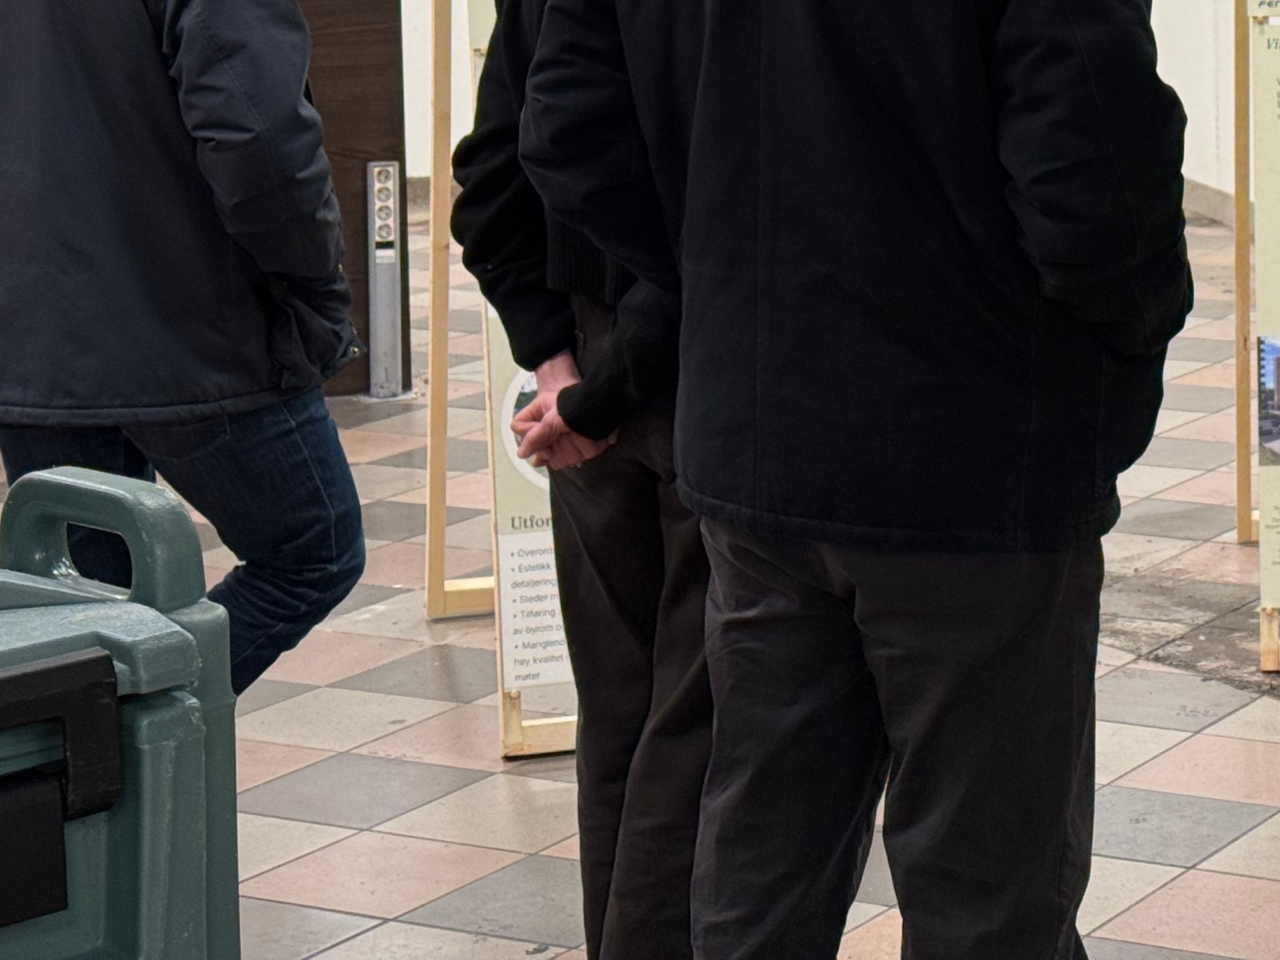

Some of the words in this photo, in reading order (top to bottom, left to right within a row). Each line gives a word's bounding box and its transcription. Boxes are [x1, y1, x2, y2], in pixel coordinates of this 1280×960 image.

[510, 515, 552, 530] Utfor
[517, 548, 553, 558] Overord
[522, 640, 566, 650] Manglend
[532, 654, 564, 665] kvalitet
